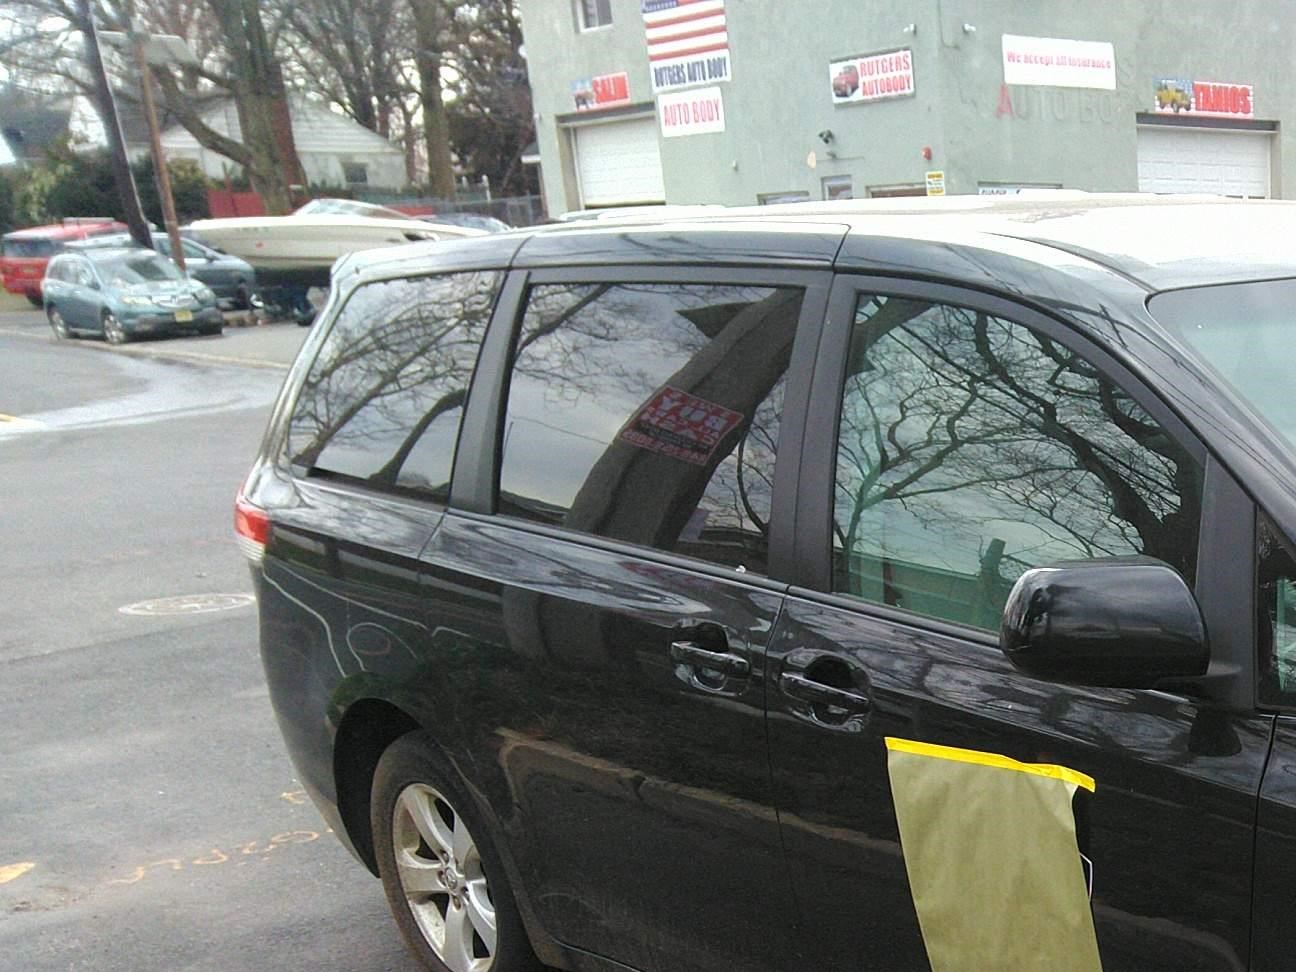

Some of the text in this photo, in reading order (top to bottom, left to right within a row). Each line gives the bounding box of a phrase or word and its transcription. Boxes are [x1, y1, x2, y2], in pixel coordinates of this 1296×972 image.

[860, 53, 910, 78] RUTGERS
[1007, 51, 1022, 63] We
[1023, 55, 1054, 67] accept
[654, 56, 729, 88] RUTGERS AUTO BODY
[862, 74, 912, 97] AUTOBODY
[663, 99, 721, 127] AUTO BODY
